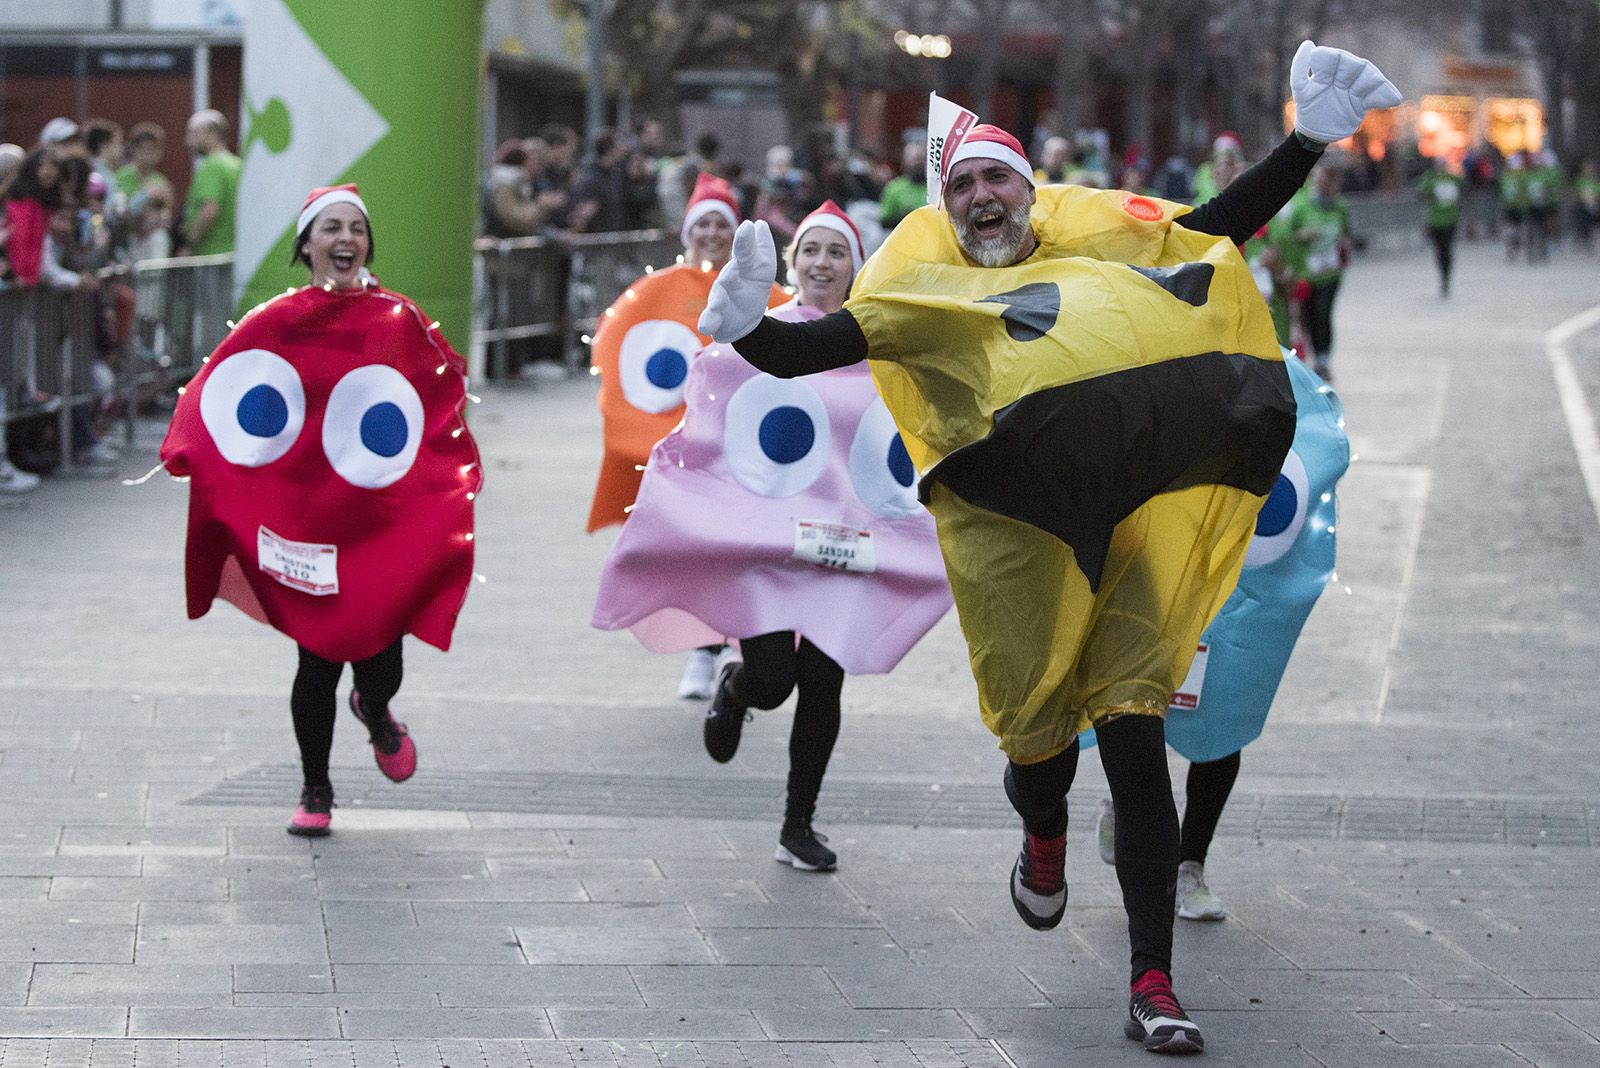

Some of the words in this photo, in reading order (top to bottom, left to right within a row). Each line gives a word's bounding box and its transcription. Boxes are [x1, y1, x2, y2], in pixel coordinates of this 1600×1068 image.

[934, 136, 944, 174] 508
[818, 545, 855, 560] SANDRA
[275, 552, 317, 573] CRISTINA
[283, 565, 310, 580] 510
